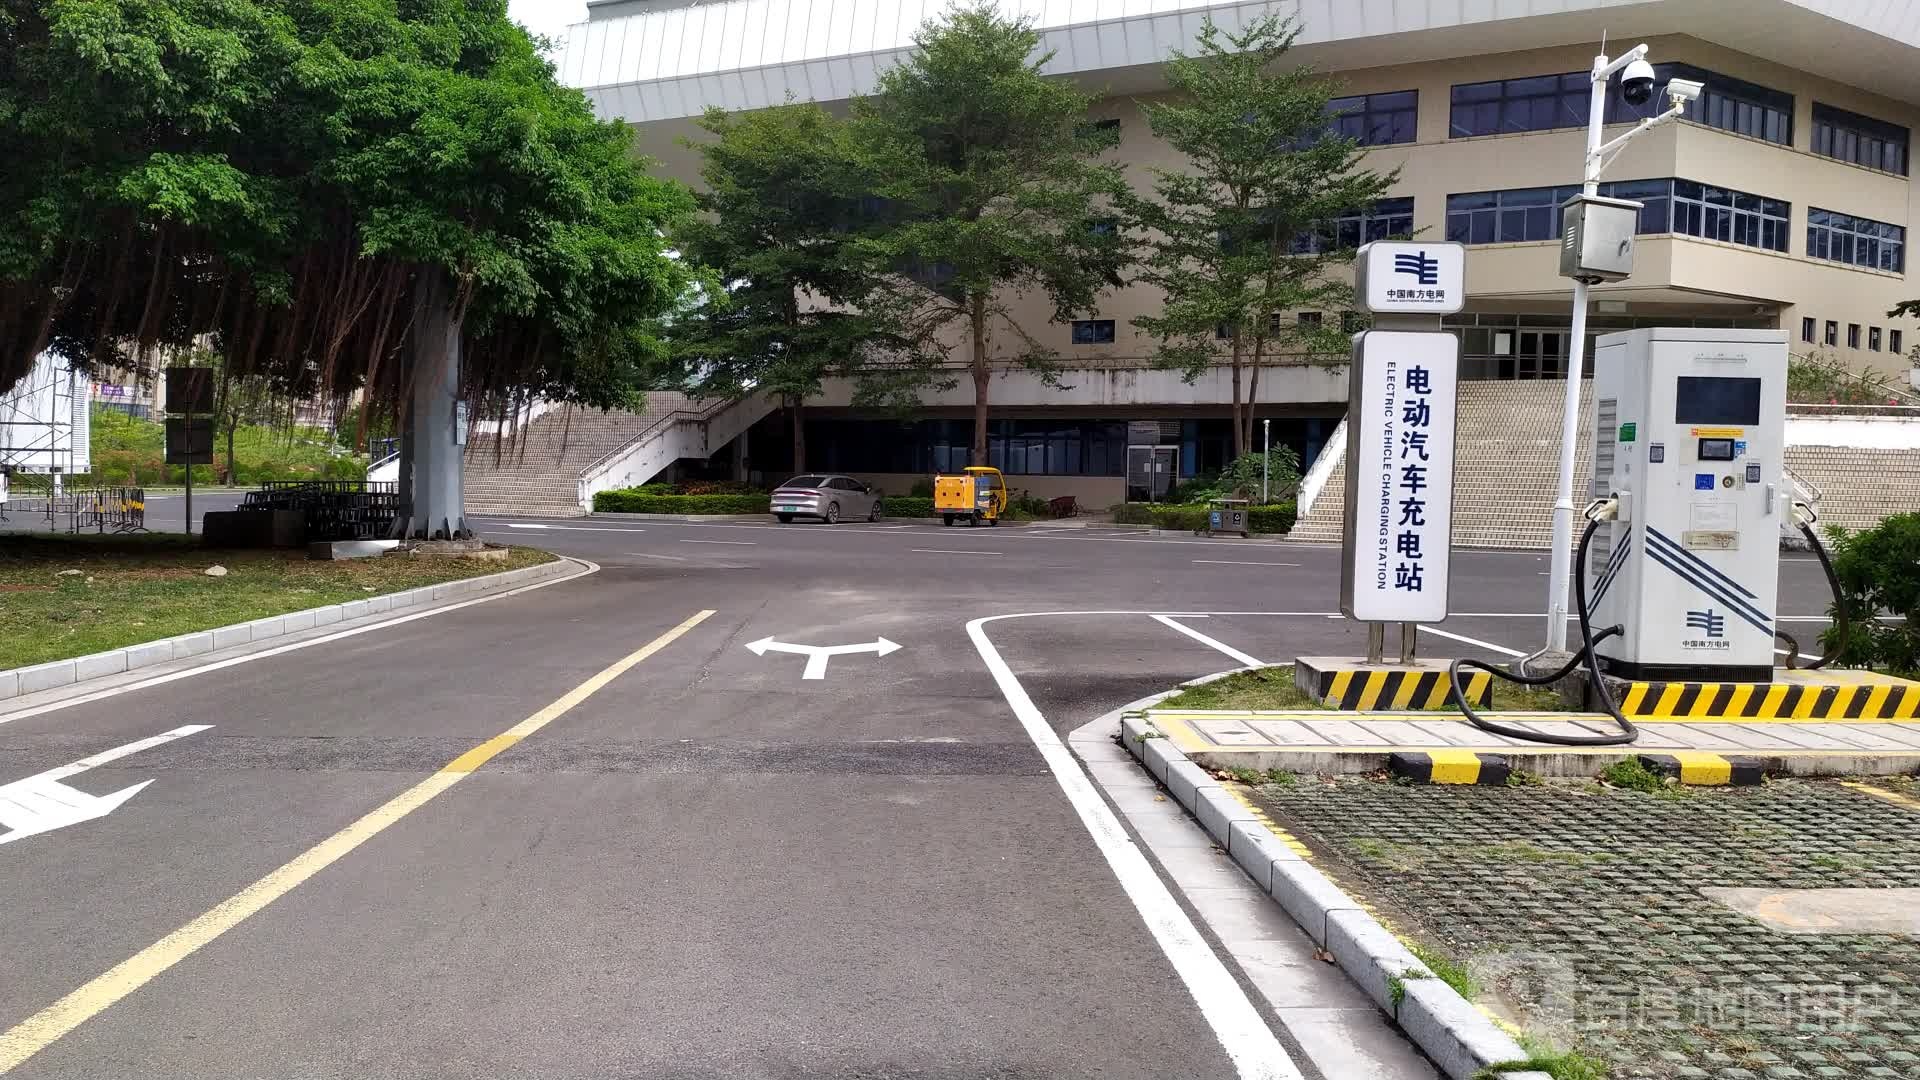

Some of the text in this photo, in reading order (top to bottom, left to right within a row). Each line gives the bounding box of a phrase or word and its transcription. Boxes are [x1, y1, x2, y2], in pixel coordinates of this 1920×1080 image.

[1386, 289, 1445, 299] 中国南方电网
[1377, 362, 1396, 590] ELECTRIC VEHICLE CHARGING STATION
[1395, 365, 1433, 592] 电动汽车充电站
